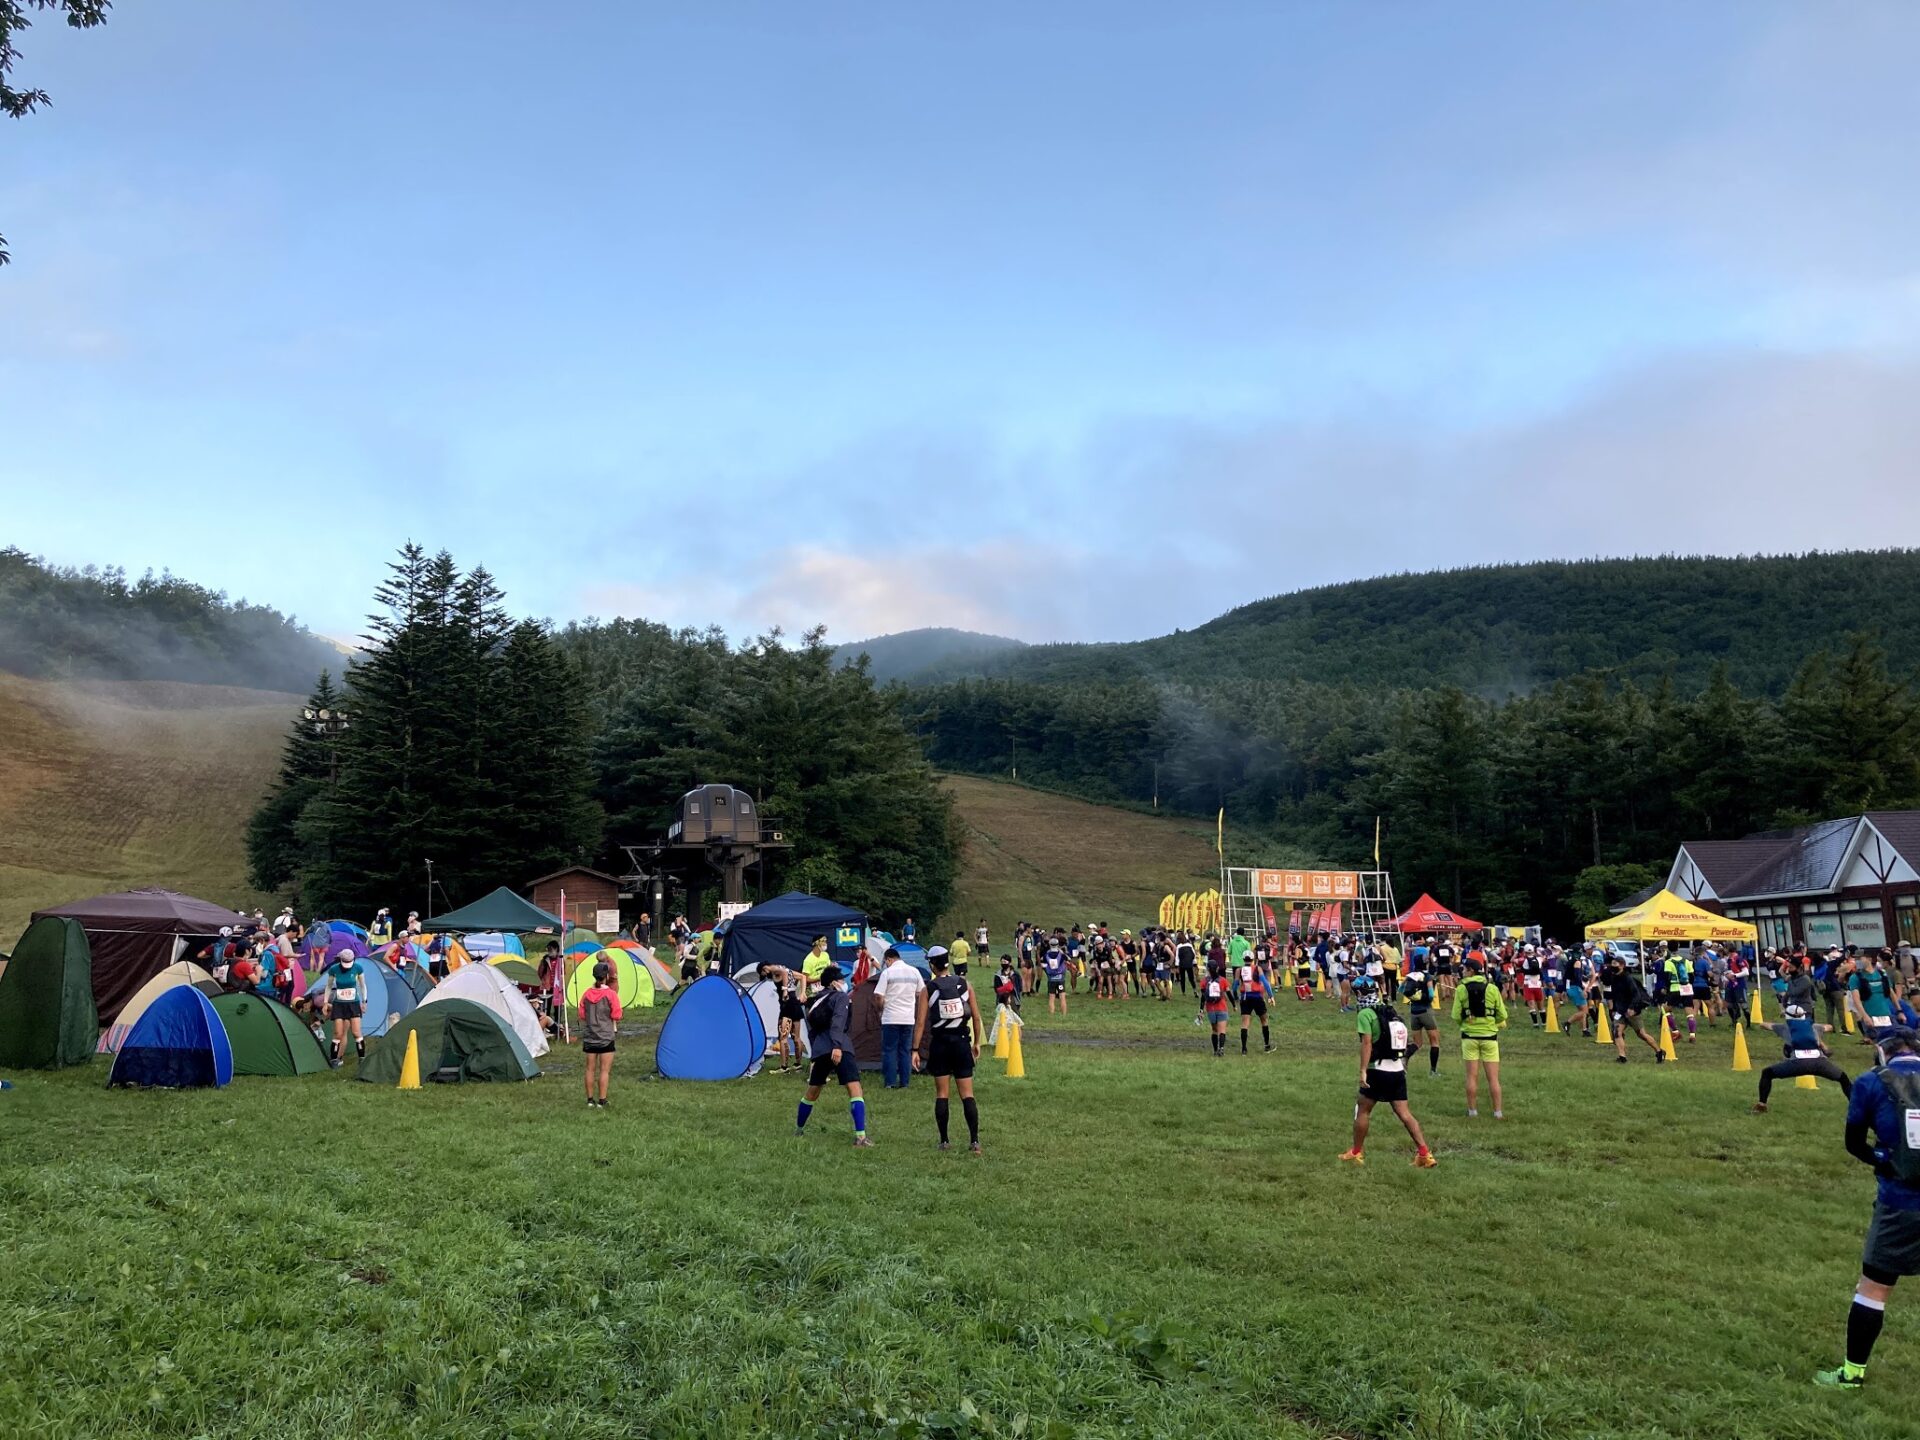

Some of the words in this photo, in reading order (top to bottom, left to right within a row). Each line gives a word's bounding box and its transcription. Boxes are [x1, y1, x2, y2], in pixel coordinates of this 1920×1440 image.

[1660, 911, 1708, 920] PowerBar
[1652, 927, 1687, 936] PowerBar
[1710, 926, 1745, 936] PowerBar
[944, 1004, 957, 1013] 131
